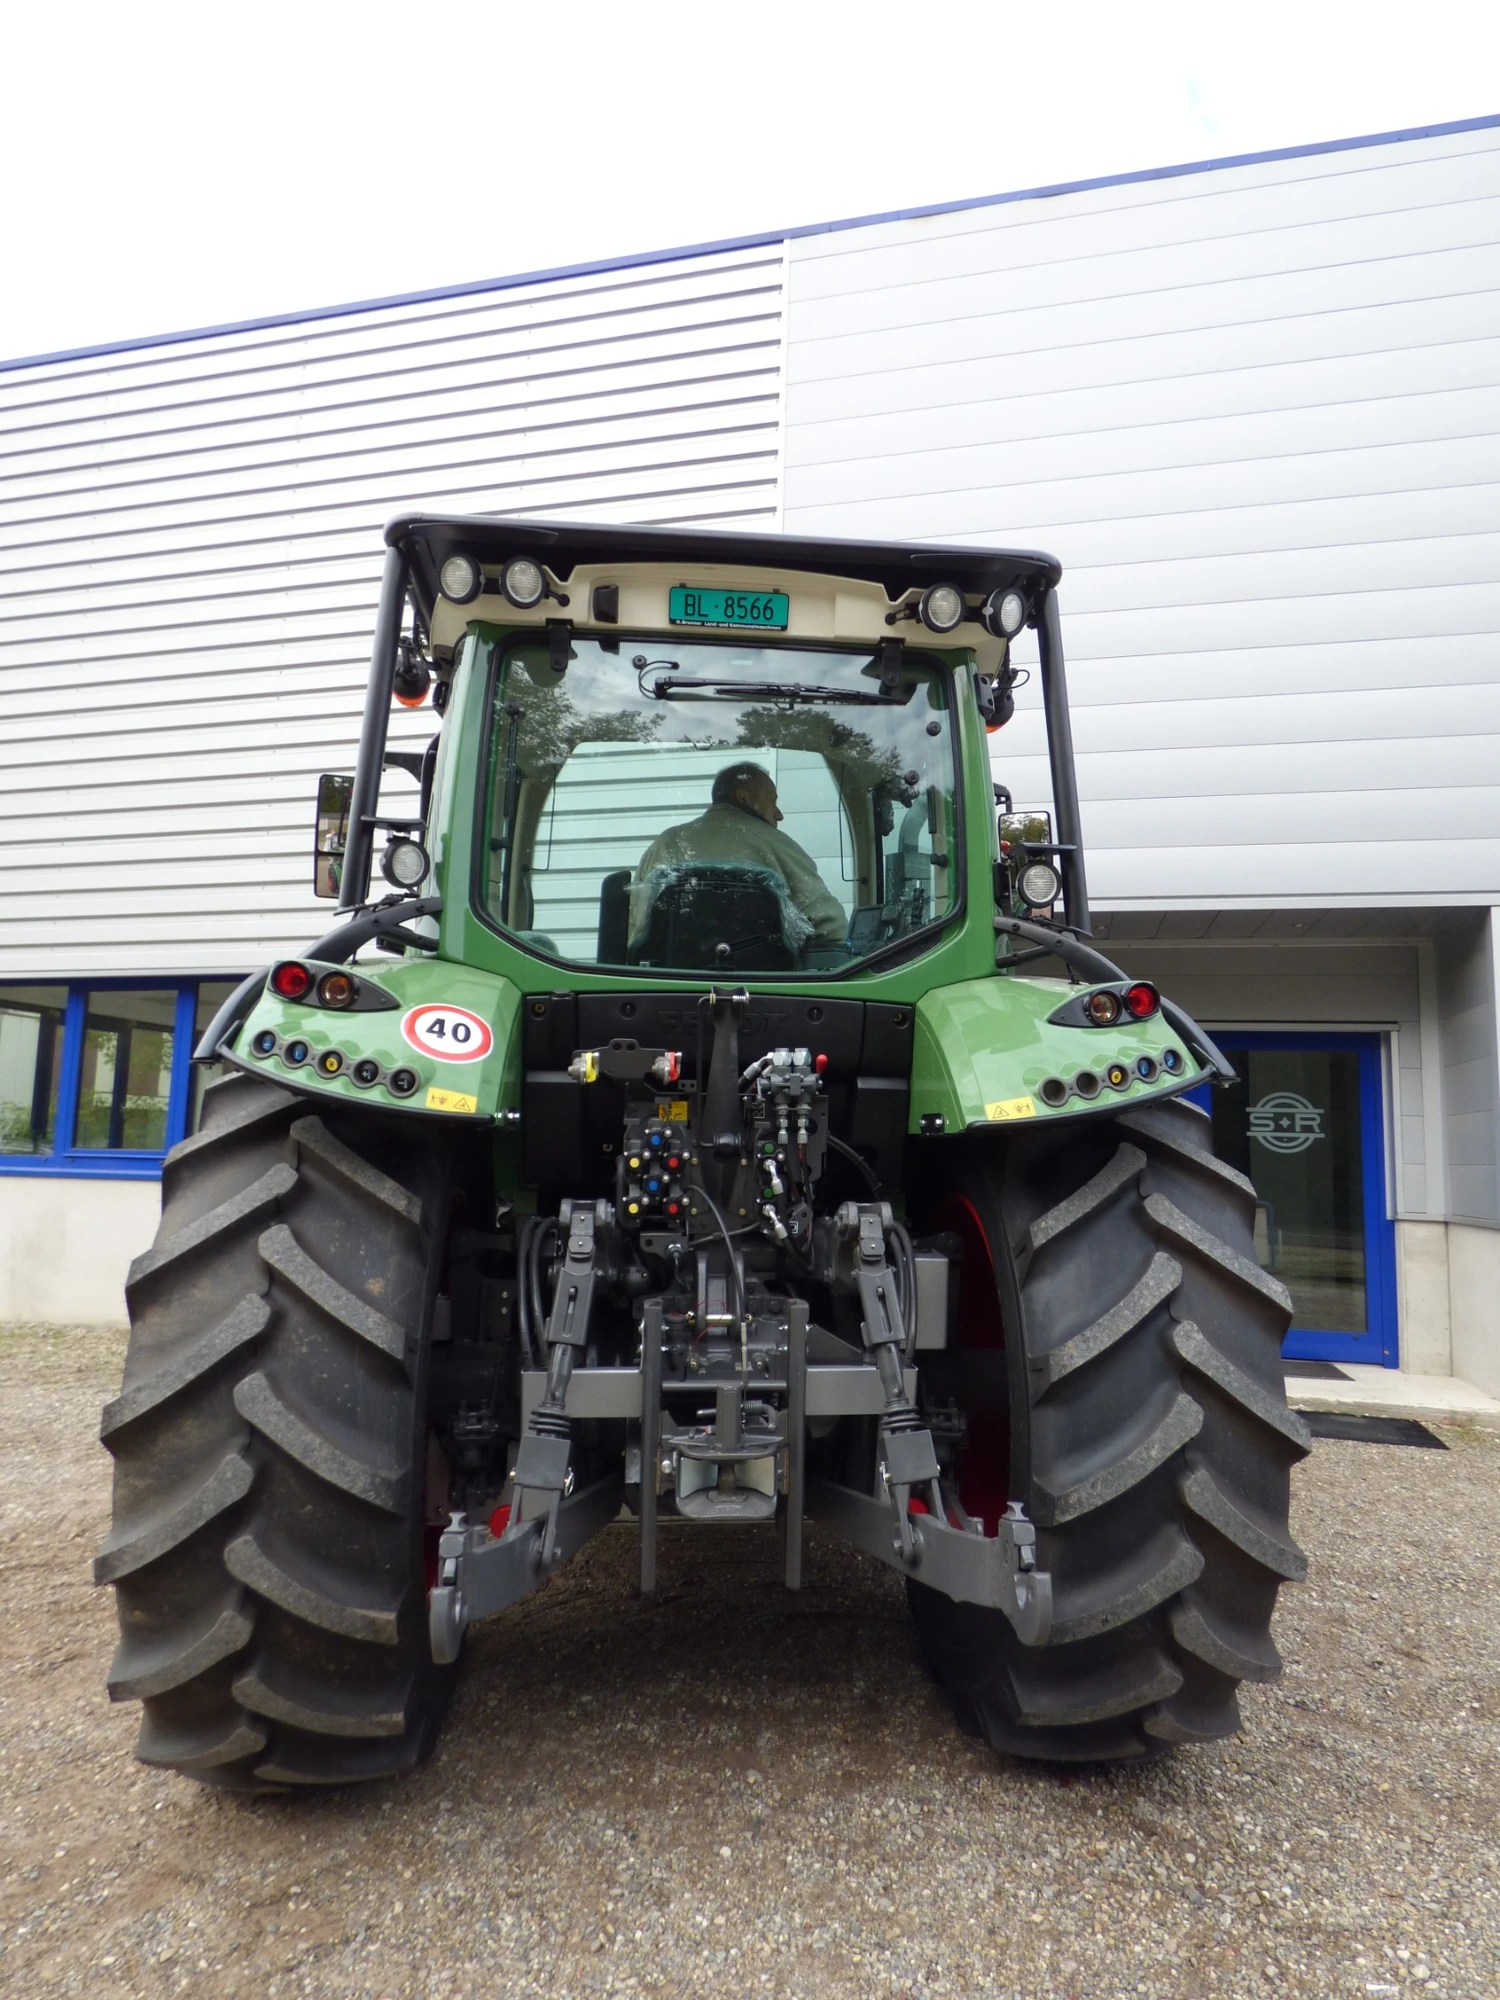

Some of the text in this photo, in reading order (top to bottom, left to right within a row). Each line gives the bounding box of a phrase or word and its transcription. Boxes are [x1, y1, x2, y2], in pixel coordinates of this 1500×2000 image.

[684, 594, 708, 617] BL
[724, 596, 774, 620] 8566
[426, 1018, 471, 1043] 40
[656, 1010, 788, 1037] FEDT
